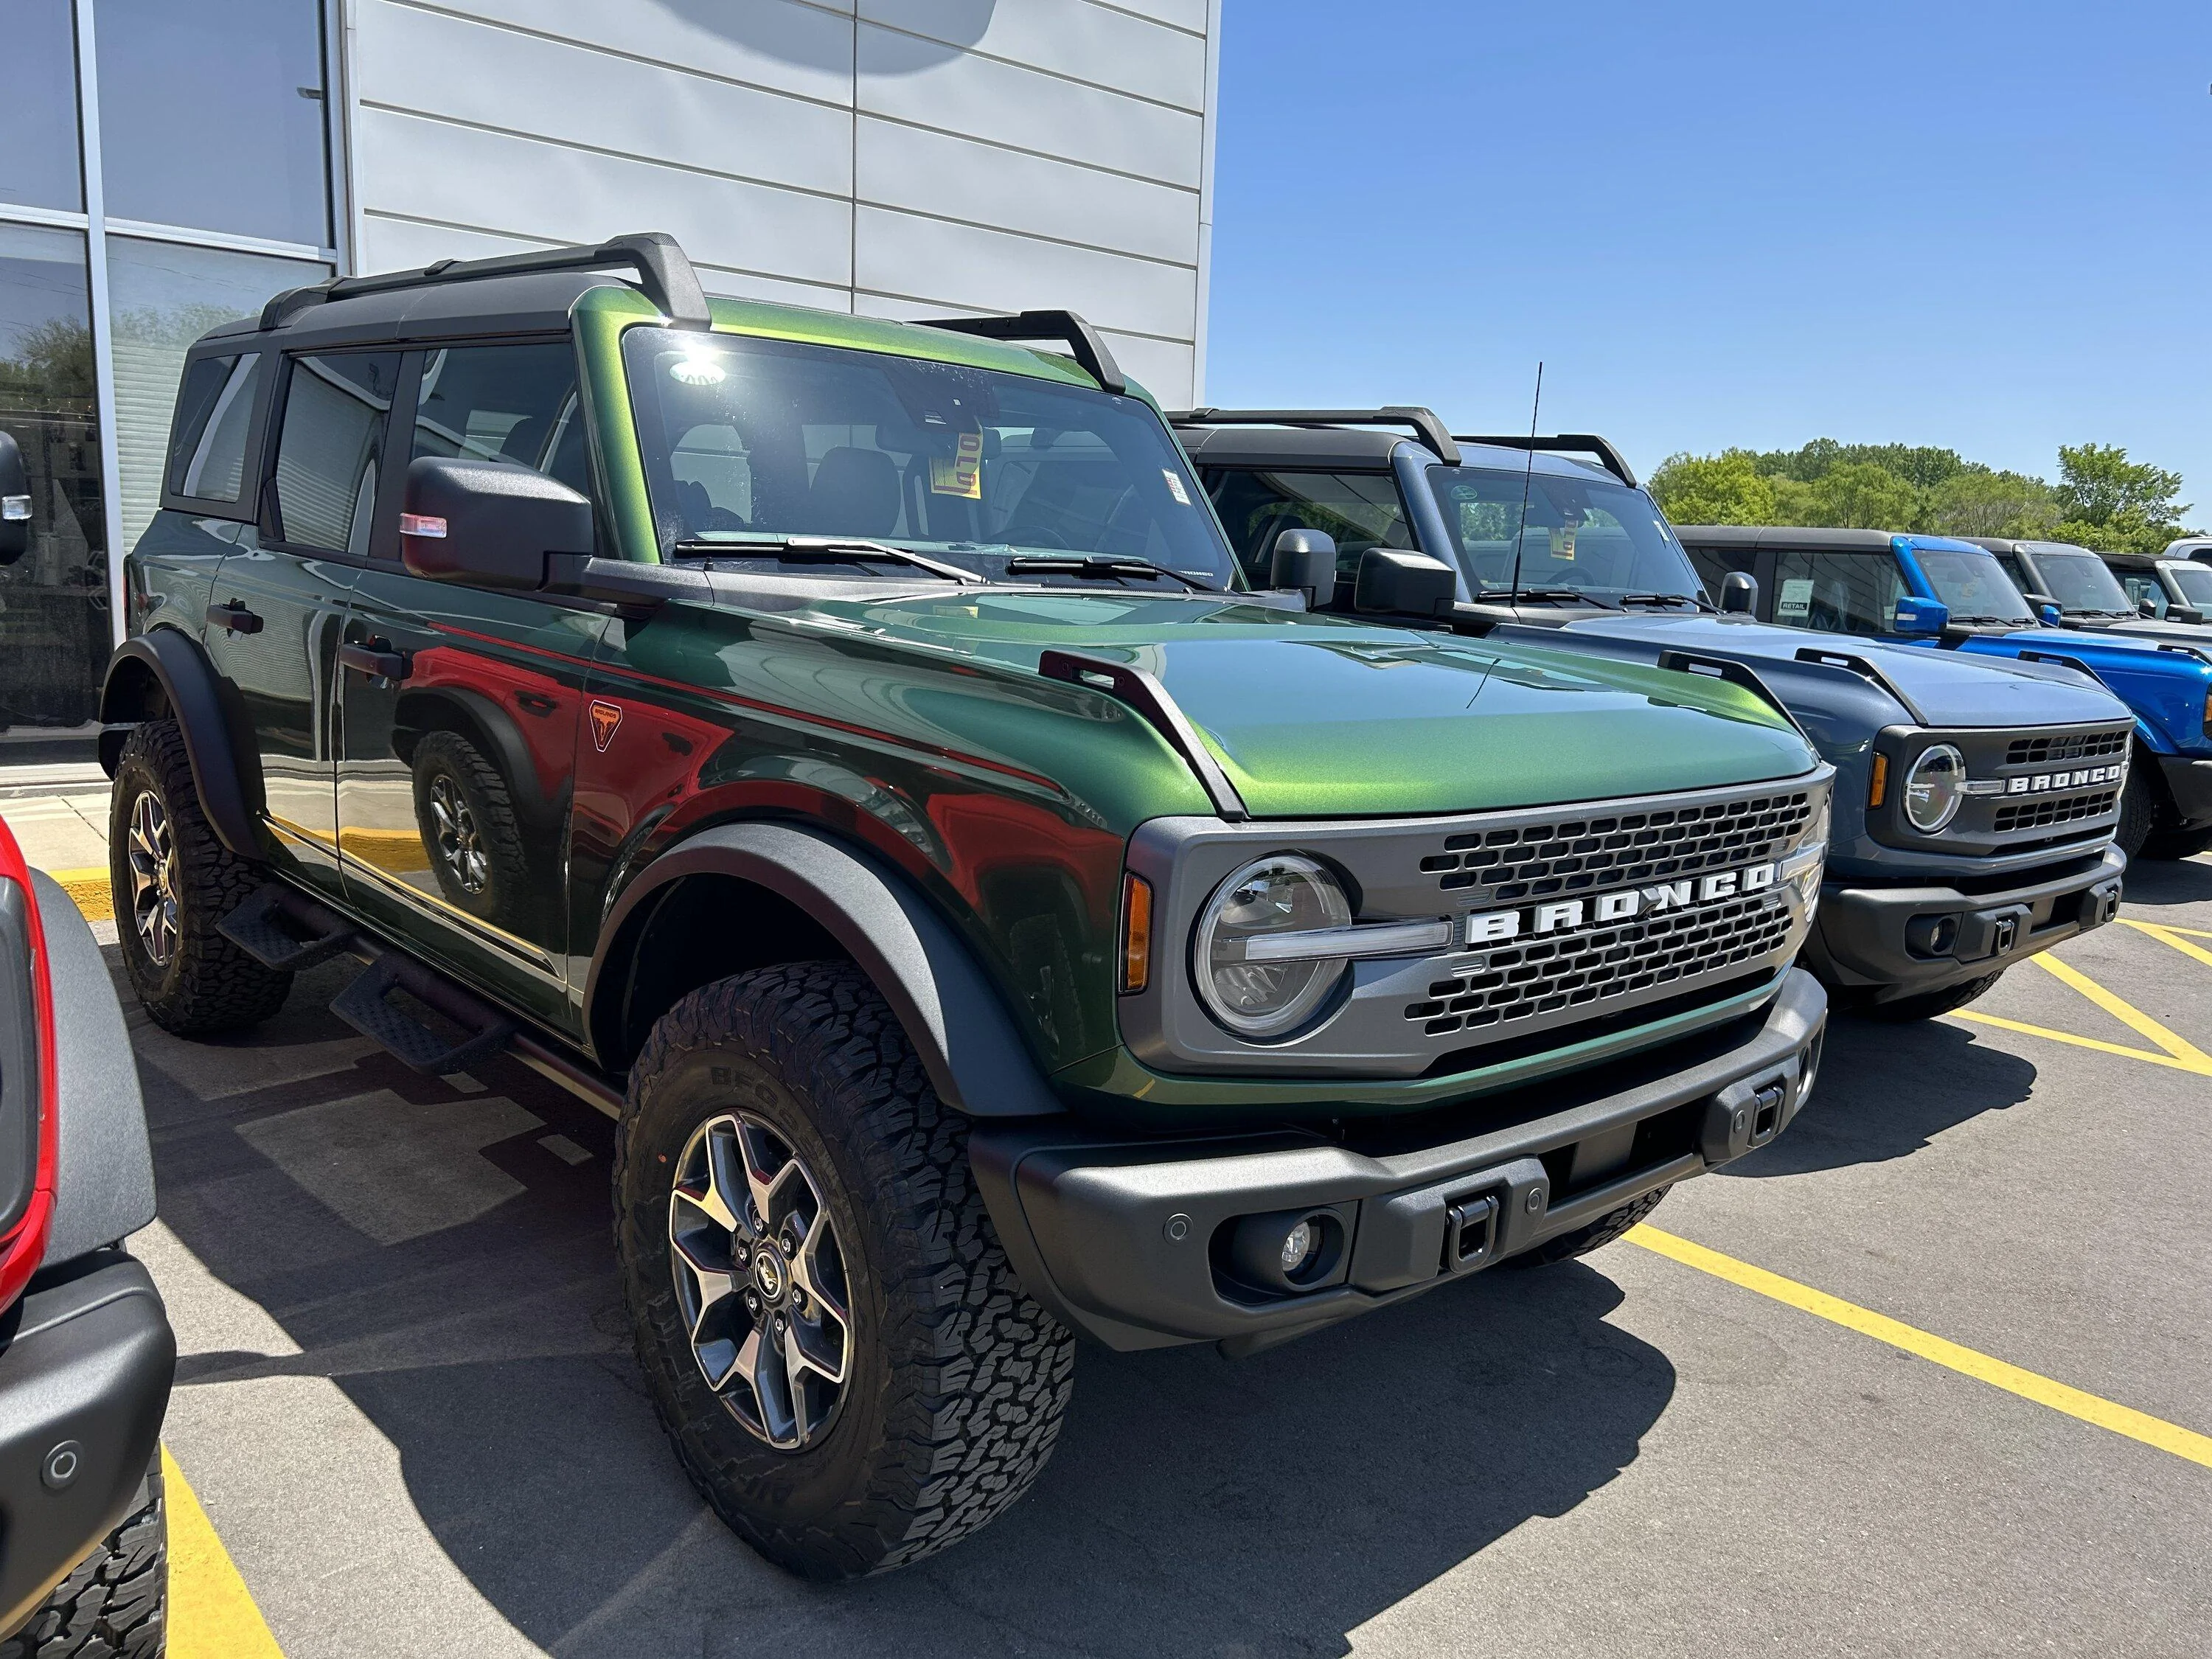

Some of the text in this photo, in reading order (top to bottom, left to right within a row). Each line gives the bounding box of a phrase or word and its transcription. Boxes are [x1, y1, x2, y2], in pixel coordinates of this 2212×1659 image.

[956, 435, 980, 487] OLD
[2008, 765, 2121, 793] BRONCO
[1464, 862, 1775, 944] BRONCO
